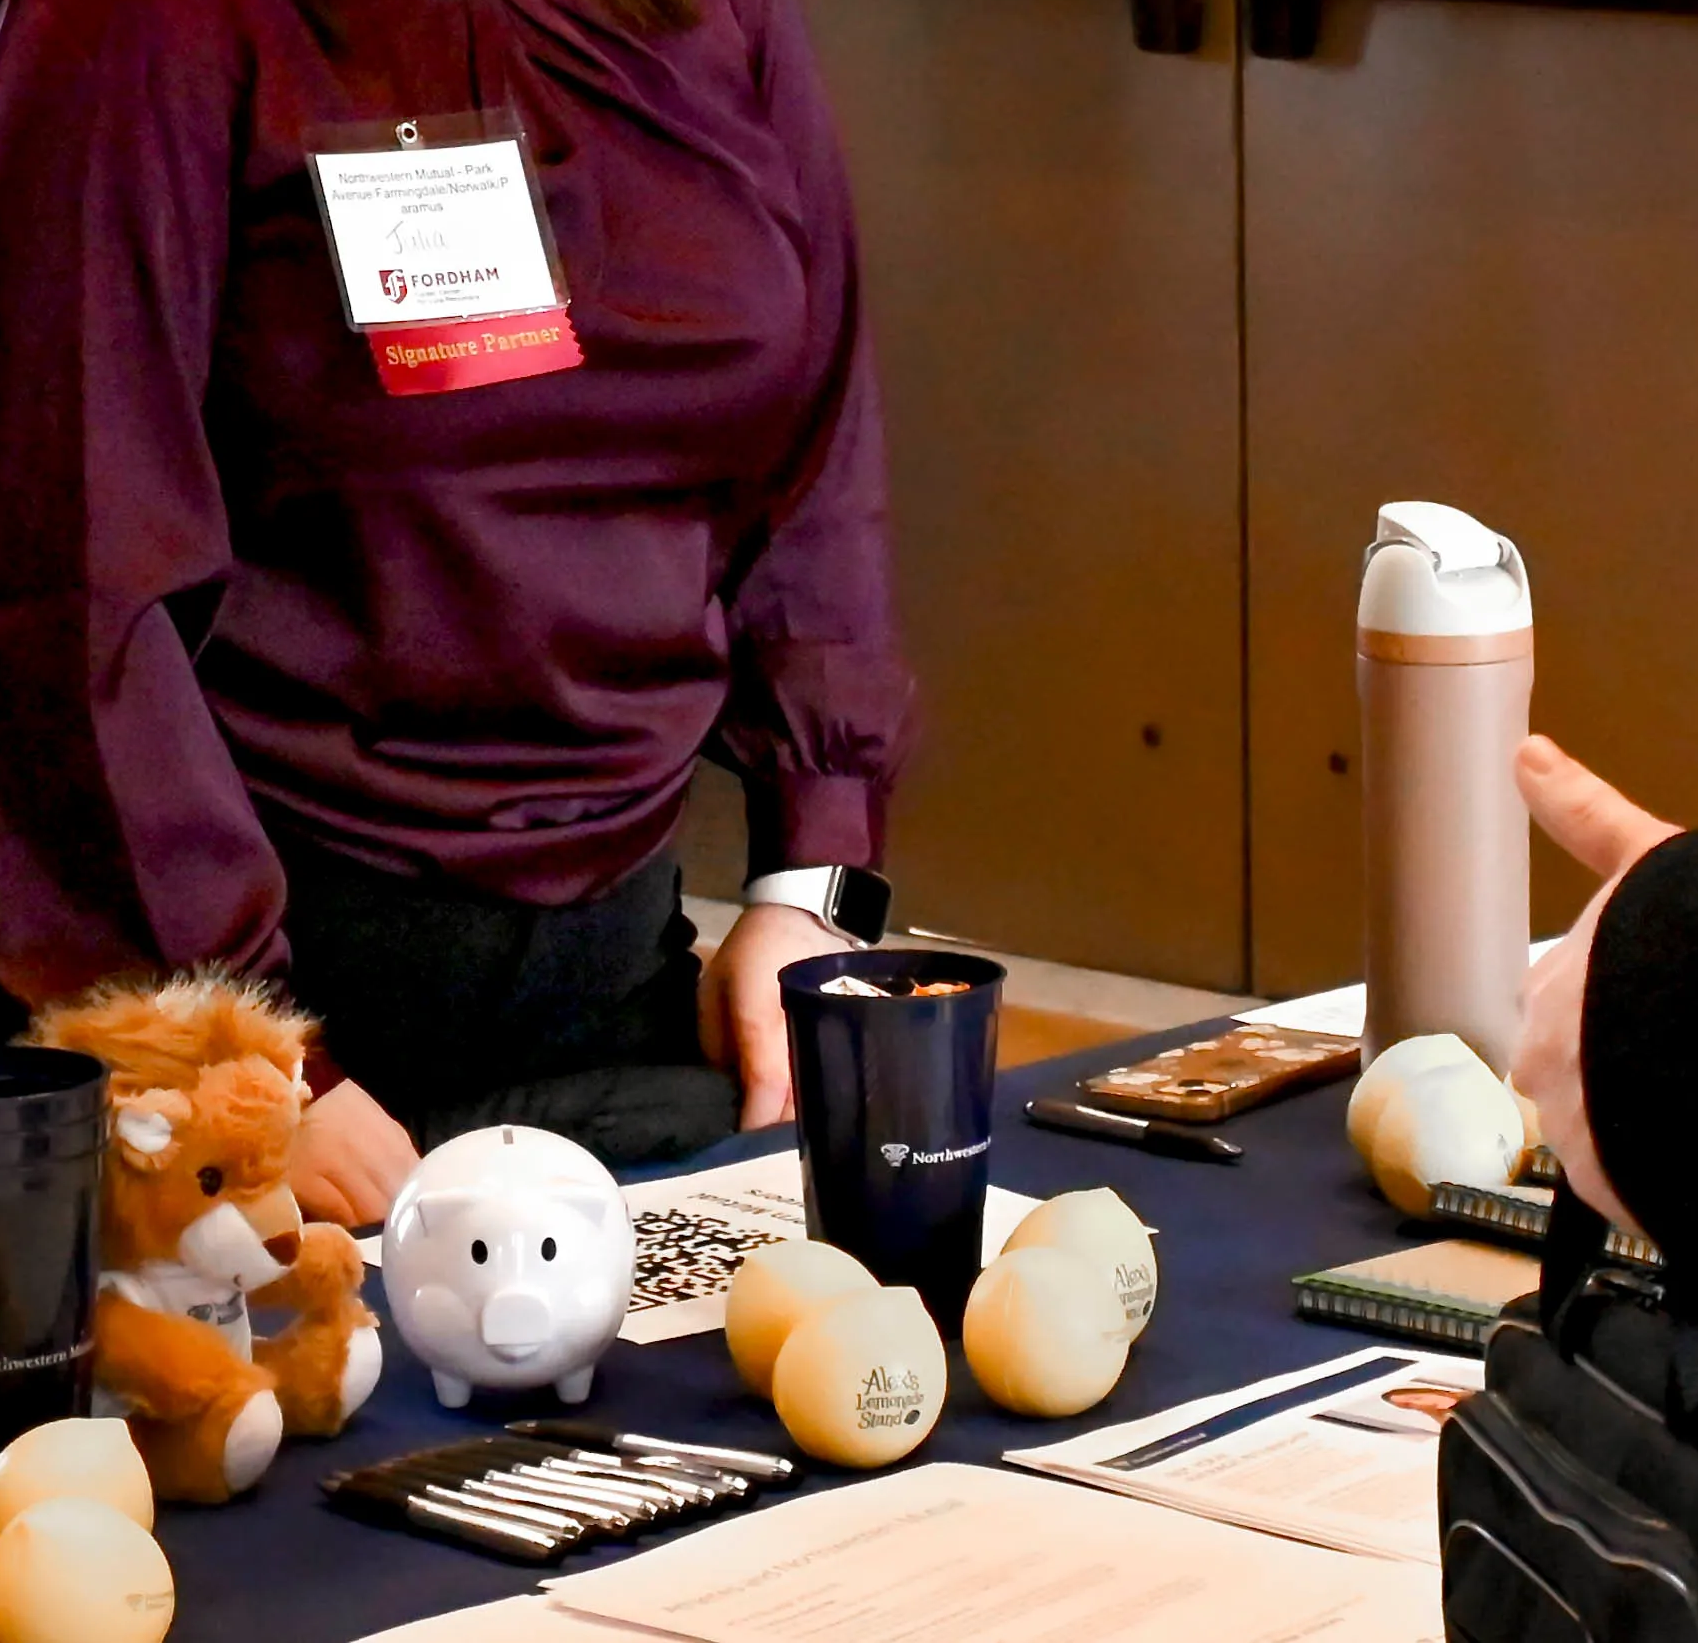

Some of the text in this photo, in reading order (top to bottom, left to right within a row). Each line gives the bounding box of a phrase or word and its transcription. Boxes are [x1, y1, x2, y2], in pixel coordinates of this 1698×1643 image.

[338, 172, 413, 185] Northwestern
[415, 166, 455, 181] Mutual
[464, 163, 494, 175] Park
[332, 188, 373, 201] Avenue
[401, 202, 444, 215] aramus
[411, 266, 500, 288] FORDHAM
[386, 326, 560, 369] Signature Partner
[857, 1410, 903, 1429] Stand
